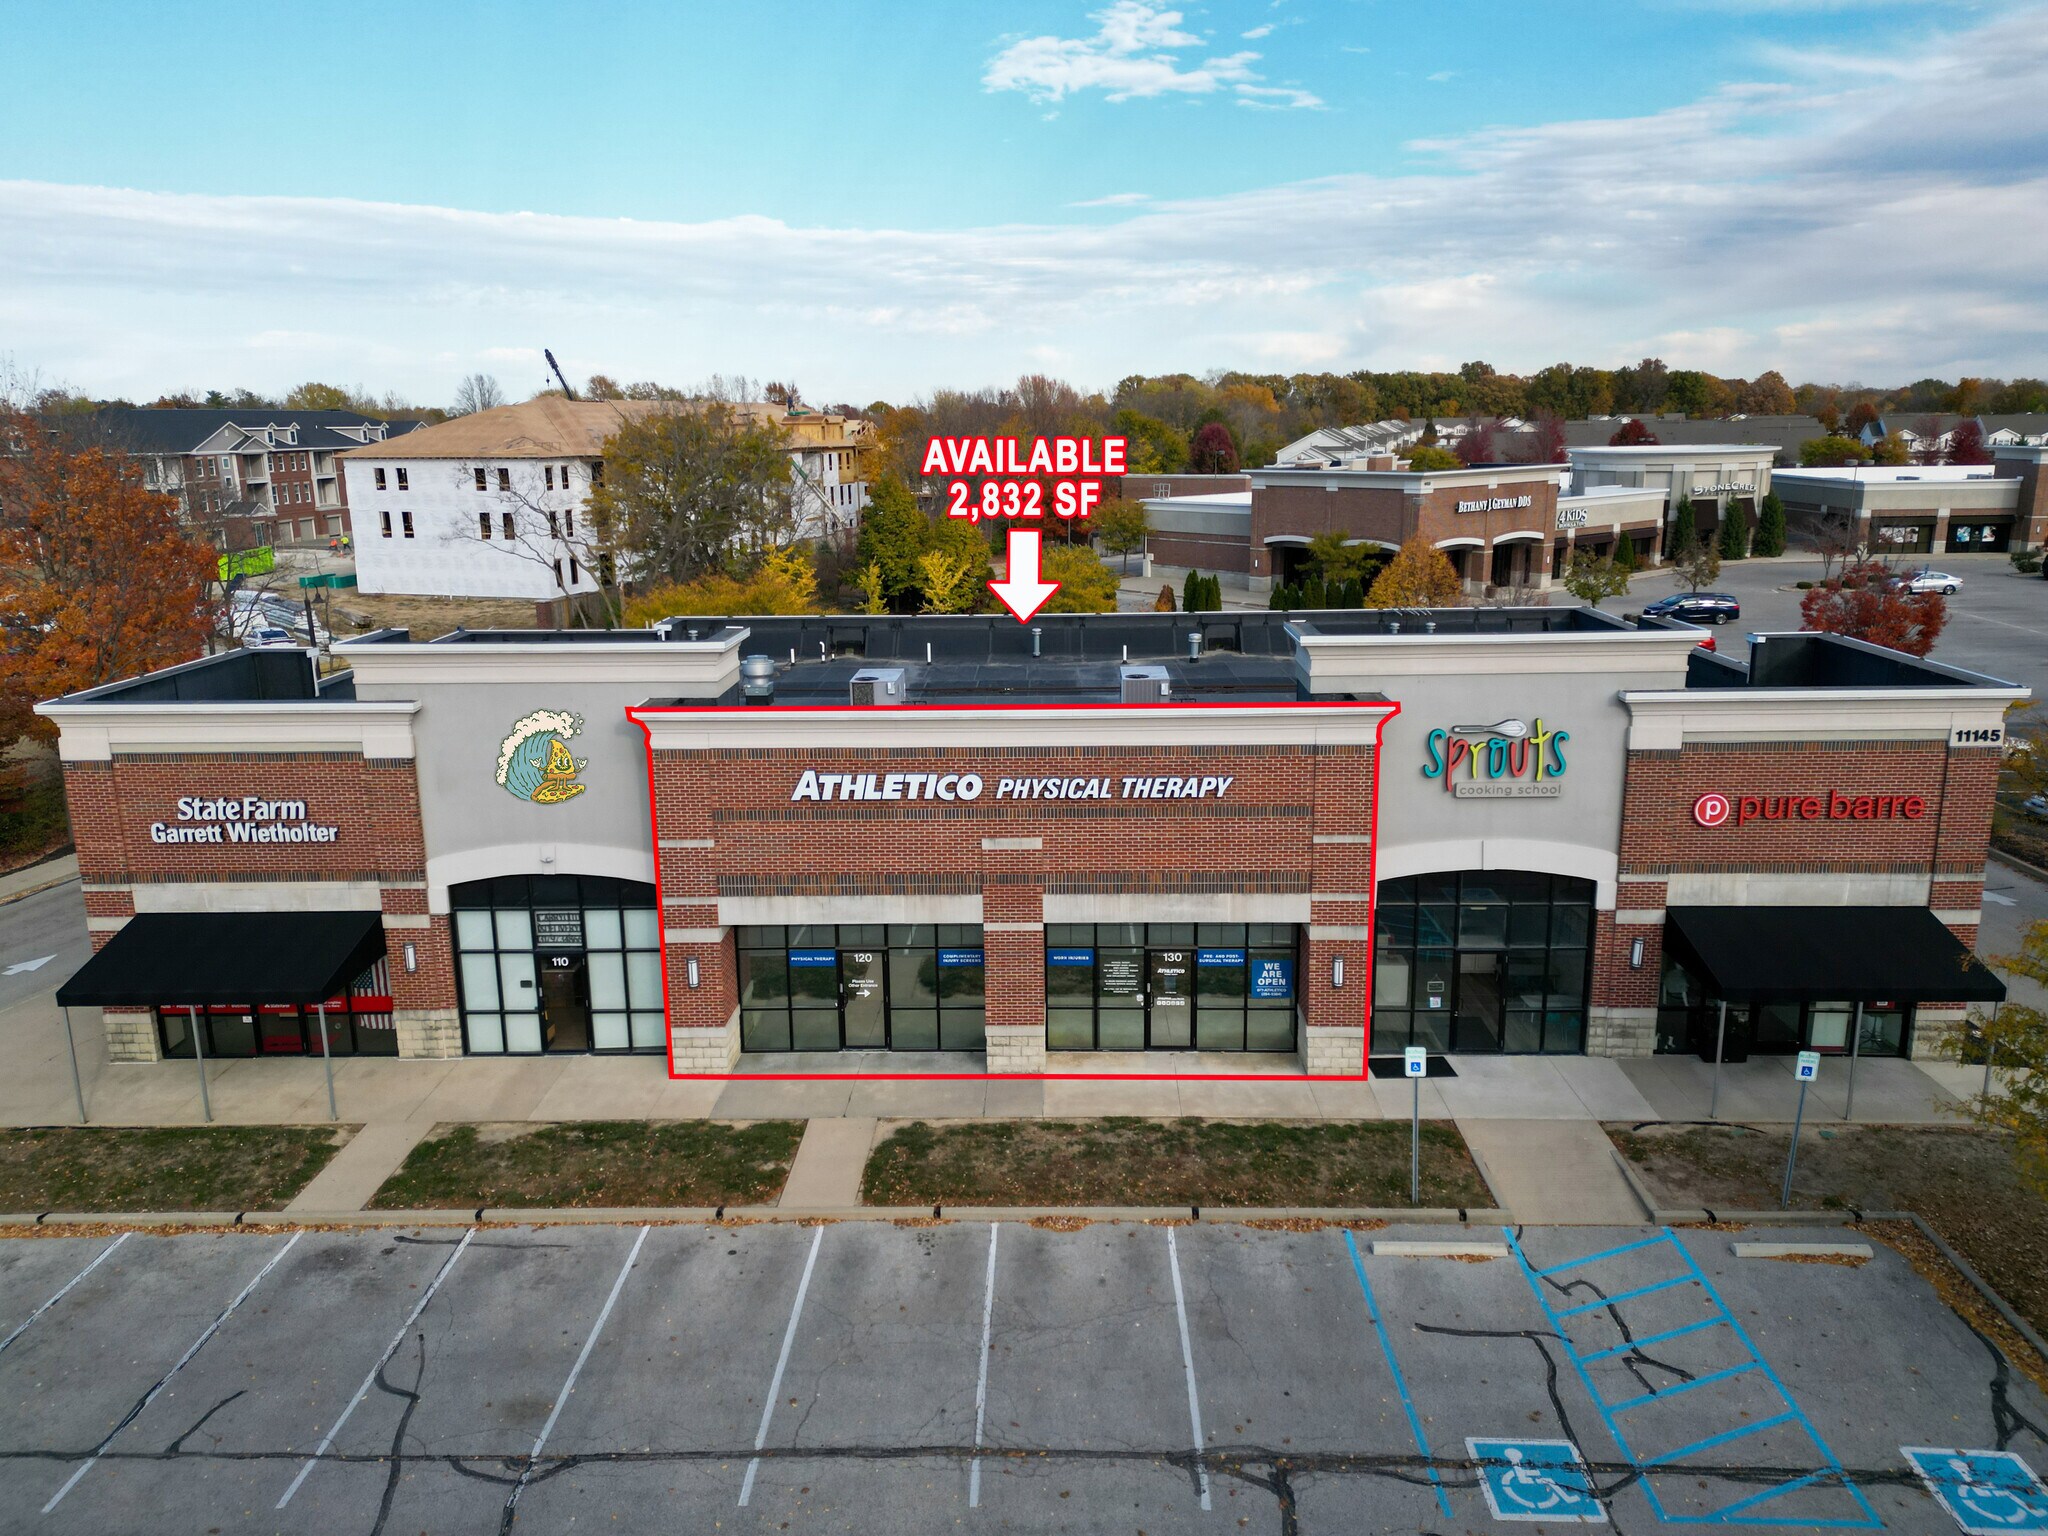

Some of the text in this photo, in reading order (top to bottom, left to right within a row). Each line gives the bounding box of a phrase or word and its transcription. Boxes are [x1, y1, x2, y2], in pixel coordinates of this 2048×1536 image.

[1457, 500, 1488, 513] BETHANY
[1517, 495, 1532, 508] DDS
[1558, 510, 1566, 524] 4
[1955, 729, 2001, 743] 11145
[791, 769, 1236, 801] ATHLETICO PHYSICAL THERAPY
[1459, 784, 1562, 796] cooking school
[1738, 796, 1822, 826] pure
[1828, 790, 1926, 819] barre
[150, 822, 339, 844] Garrett Wietholter
[551, 957, 569, 967] 110
[853, 953, 873, 963] 120
[1162, 952, 1183, 962] 130
[1263, 962, 1280, 970] WE
[1261, 970, 1283, 978] ARE
[1257, 978, 1286, 986] OPEN
